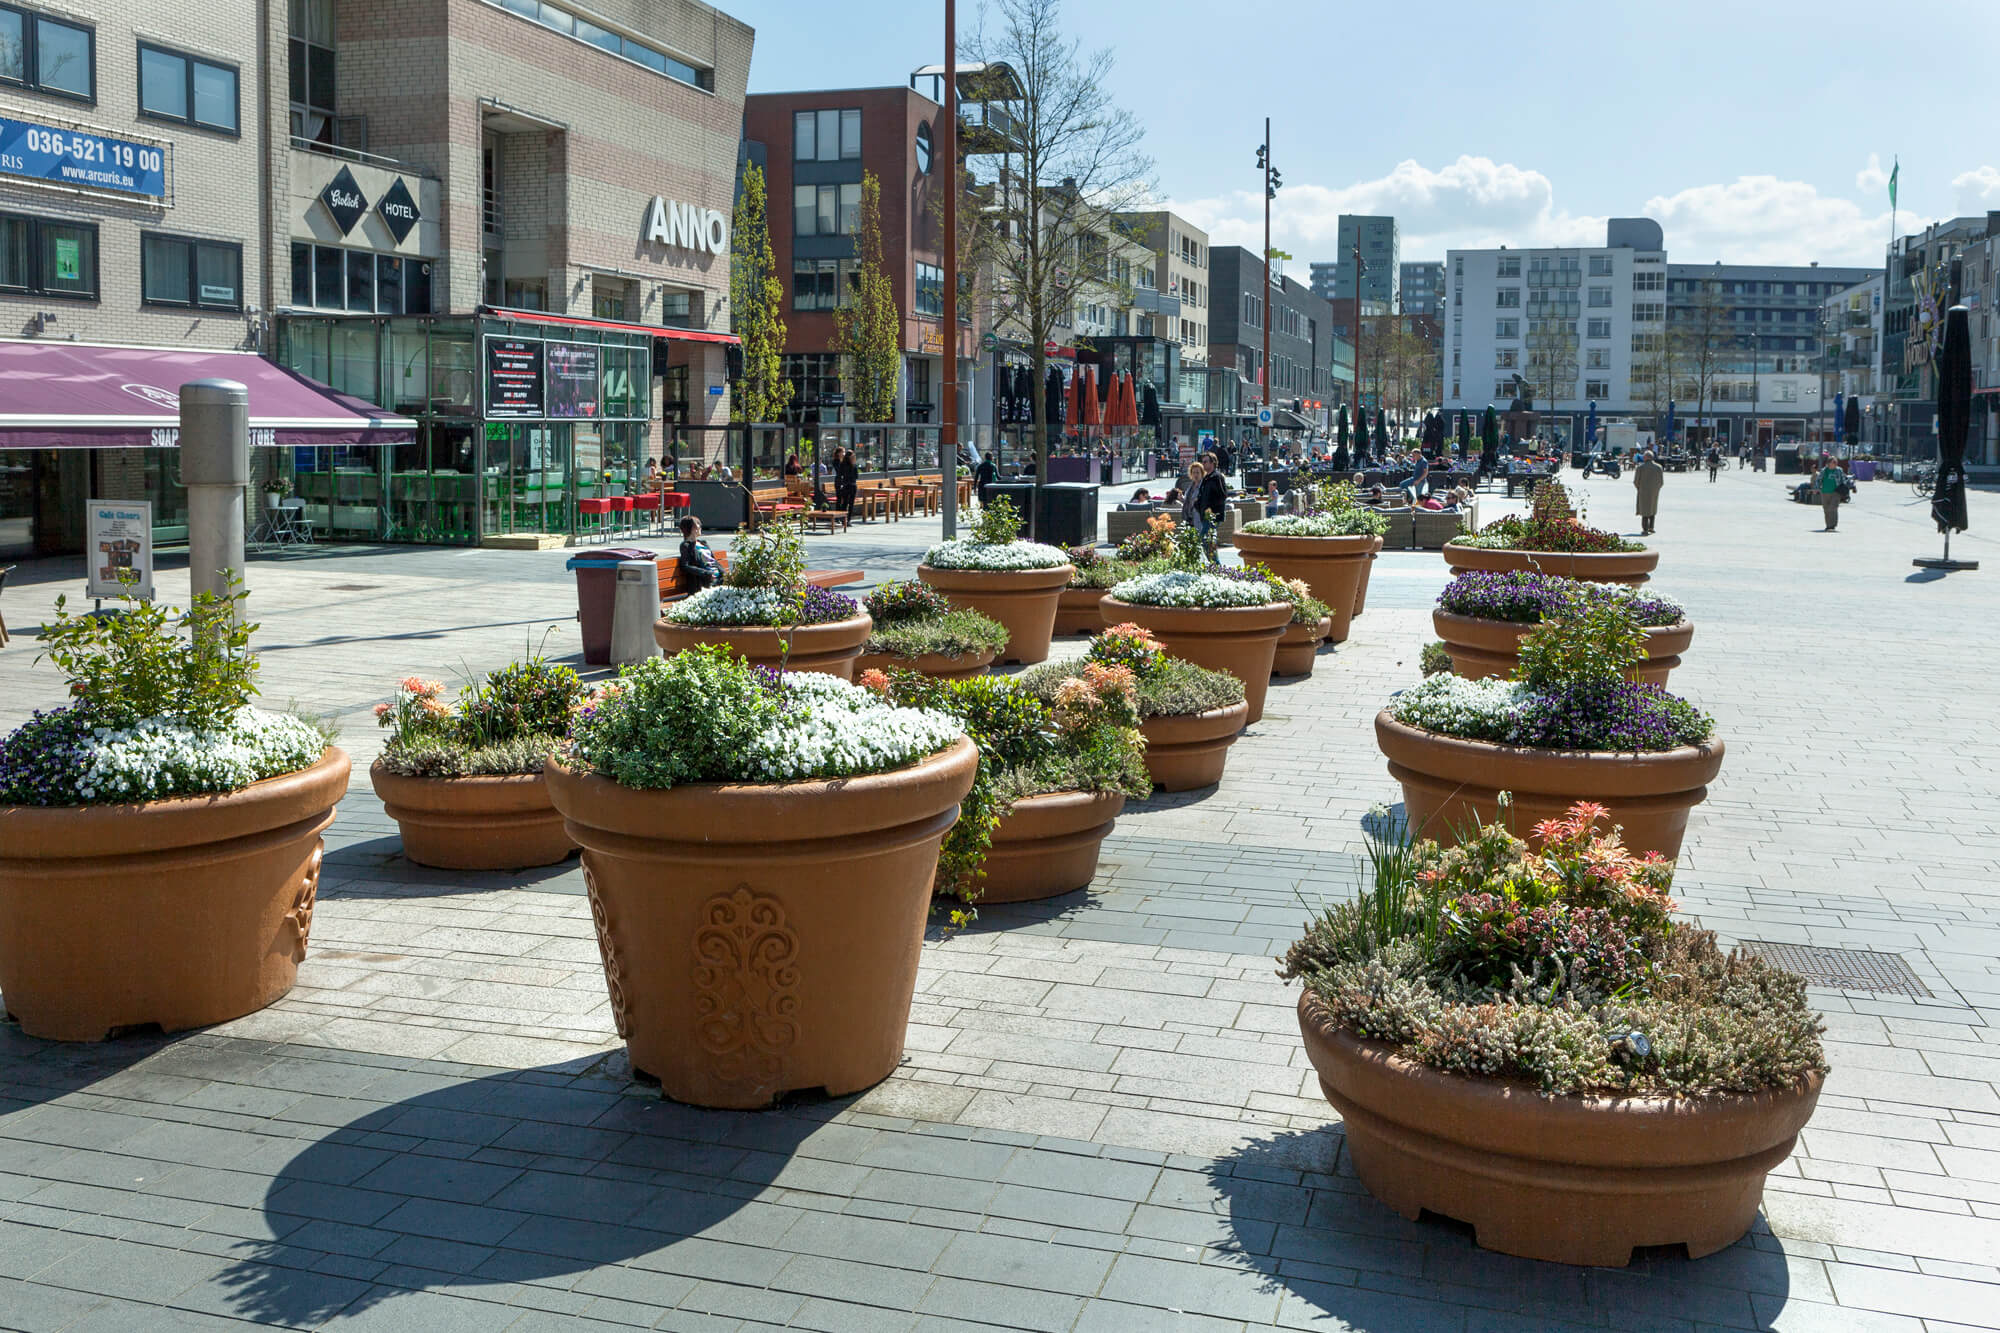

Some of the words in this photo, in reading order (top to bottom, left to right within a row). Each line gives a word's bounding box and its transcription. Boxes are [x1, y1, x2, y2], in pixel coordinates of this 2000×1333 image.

[27, 129, 105, 163] 036-521
[113, 144, 134, 168] 19
[138, 149, 161, 173] 00
[61, 165, 134, 187] www.arcuris.eu
[330, 189, 360, 209] Grolsch
[385, 202, 414, 220] HOTEL
[648, 195, 727, 257] ANNO
[151, 429, 179, 446] SOAP
